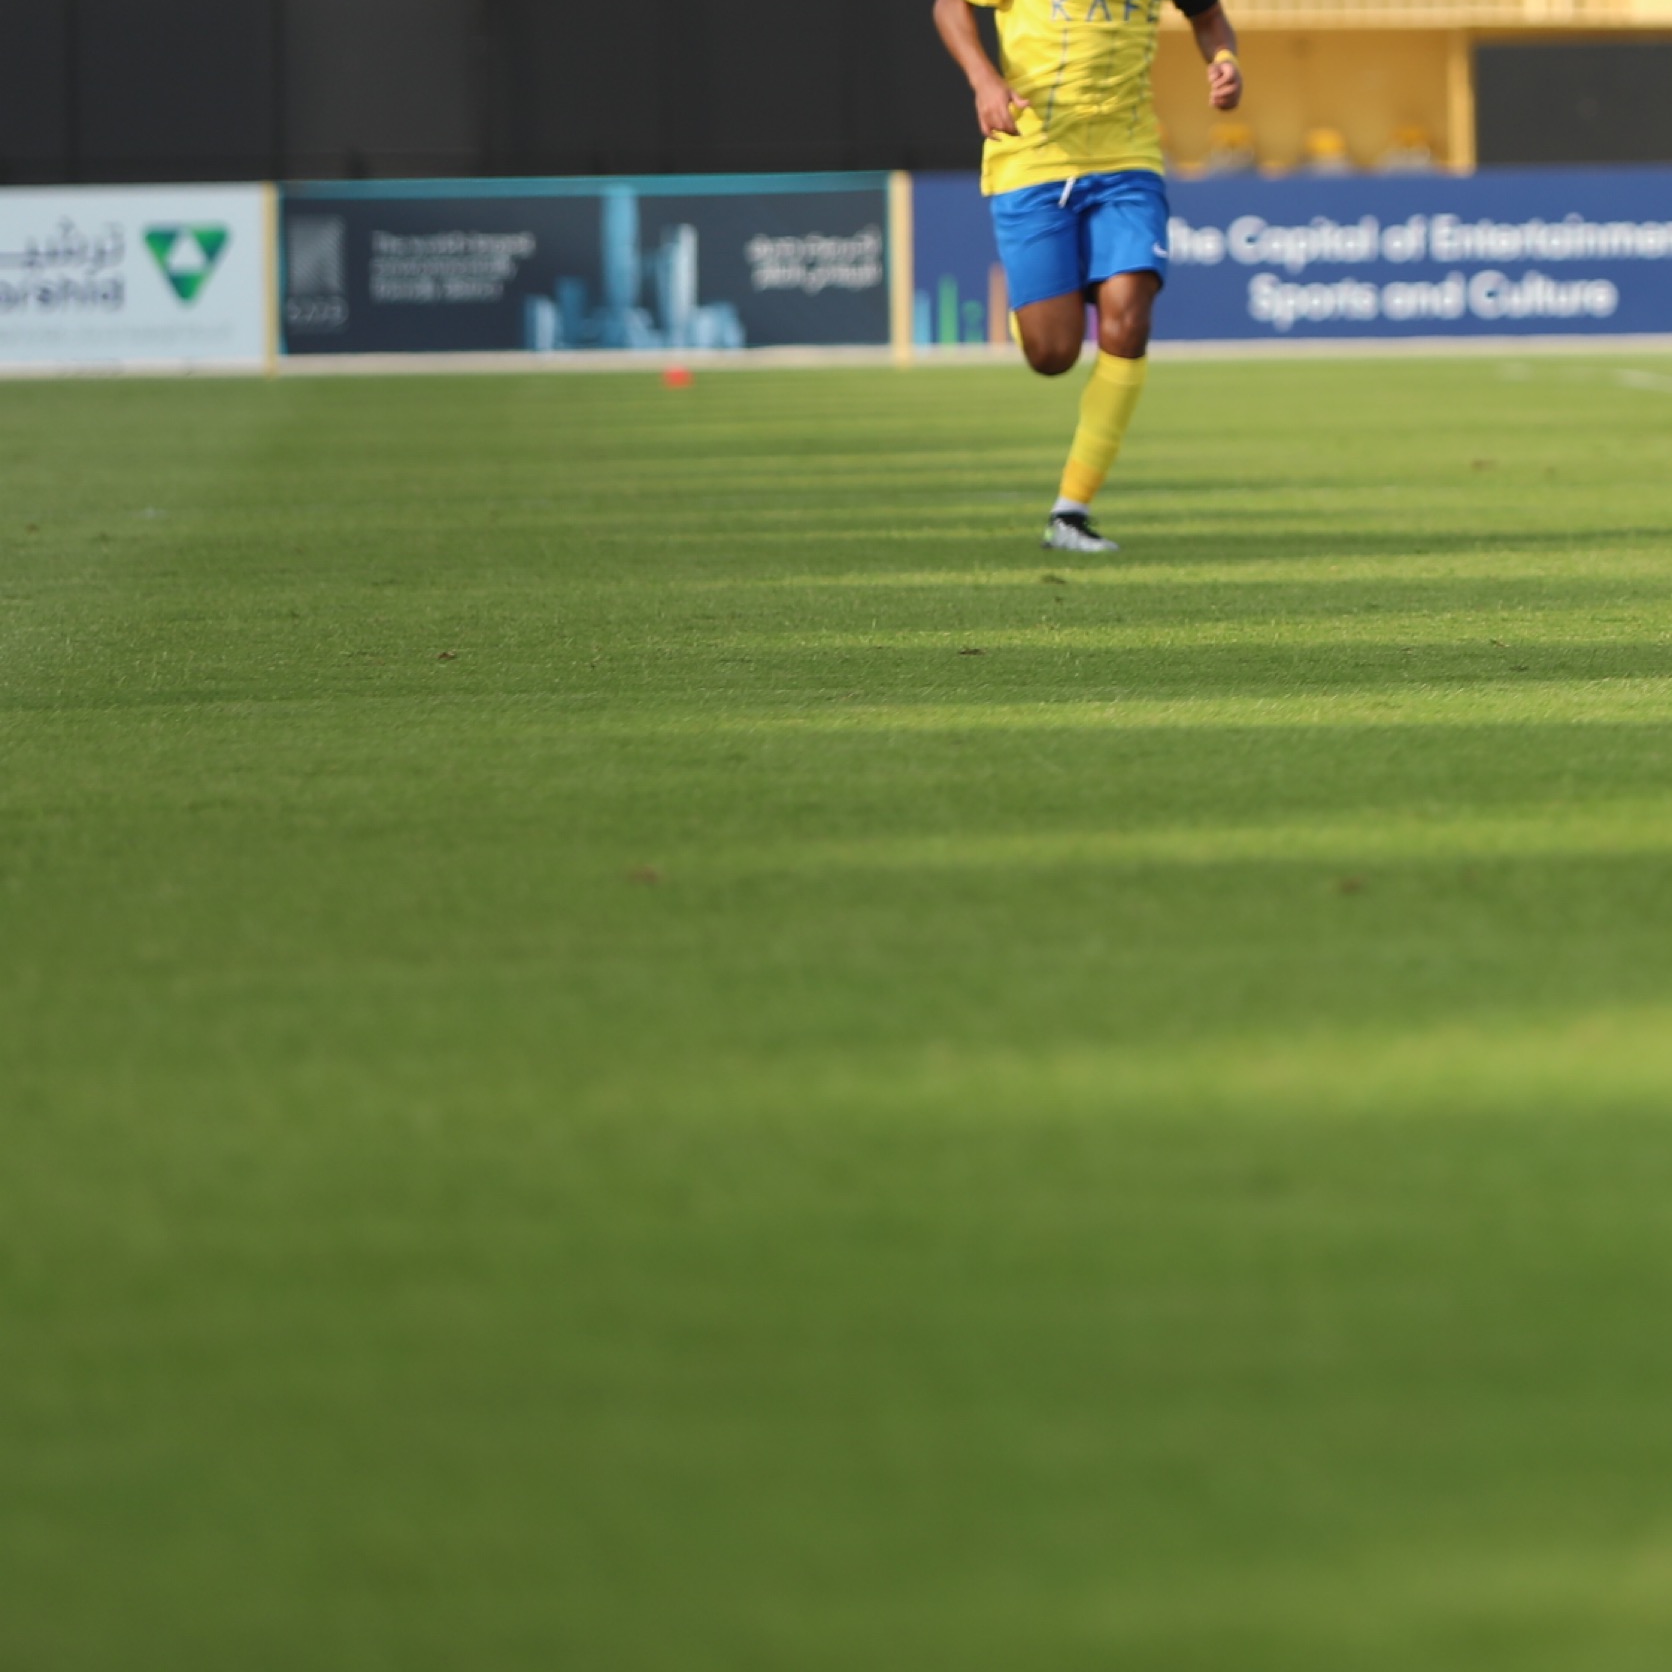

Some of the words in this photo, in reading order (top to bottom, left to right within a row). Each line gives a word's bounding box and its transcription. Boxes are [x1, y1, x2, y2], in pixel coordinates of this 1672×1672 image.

[1167, 216, 1225, 265] he
[1228, 215, 1379, 273] Capital
[1382, 214, 1427, 263] of
[1248, 272, 1379, 331] Sports
[1382, 271, 1466, 319] and
[1470, 269, 1619, 319] Culture
